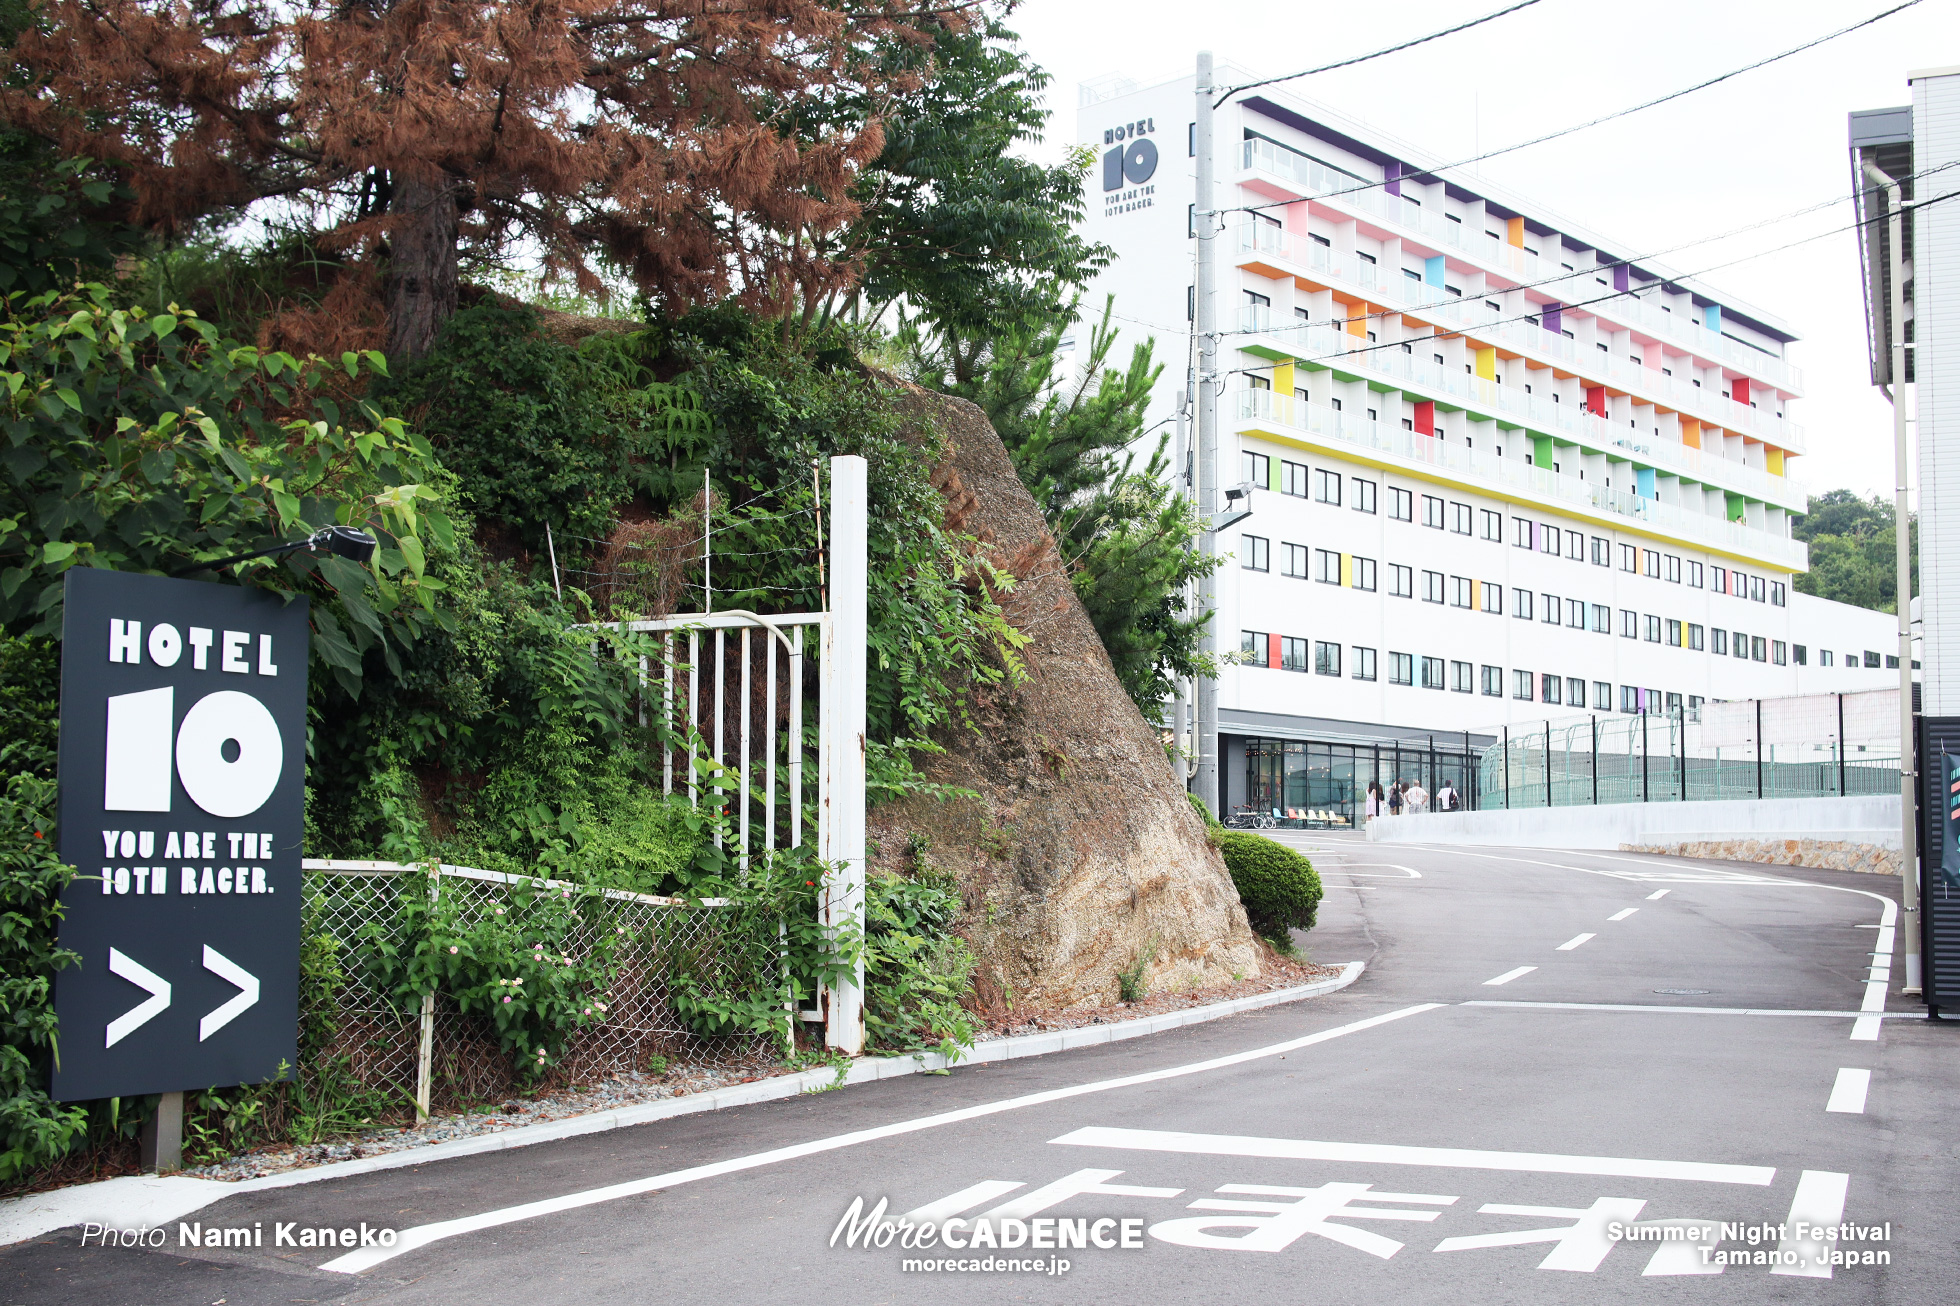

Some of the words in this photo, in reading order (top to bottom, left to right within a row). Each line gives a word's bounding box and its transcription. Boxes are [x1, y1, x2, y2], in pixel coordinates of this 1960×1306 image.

[1104, 117, 1155, 145] HOTEL
[1103, 138, 1158, 192] 10
[1105, 194, 1120, 205] YOU
[1122, 189, 1138, 201] ARE
[1140, 185, 1155, 196] THE
[1105, 205, 1123, 217] 10TH
[109, 618, 278, 676] HOTEL
[104, 686, 283, 818] 10
[102, 830, 154, 859] YOU
[164, 831, 216, 859] ARE
[227, 832, 273, 860] THE
[102, 866, 167, 895] 10TH
[181, 866, 274, 894] RACER.
